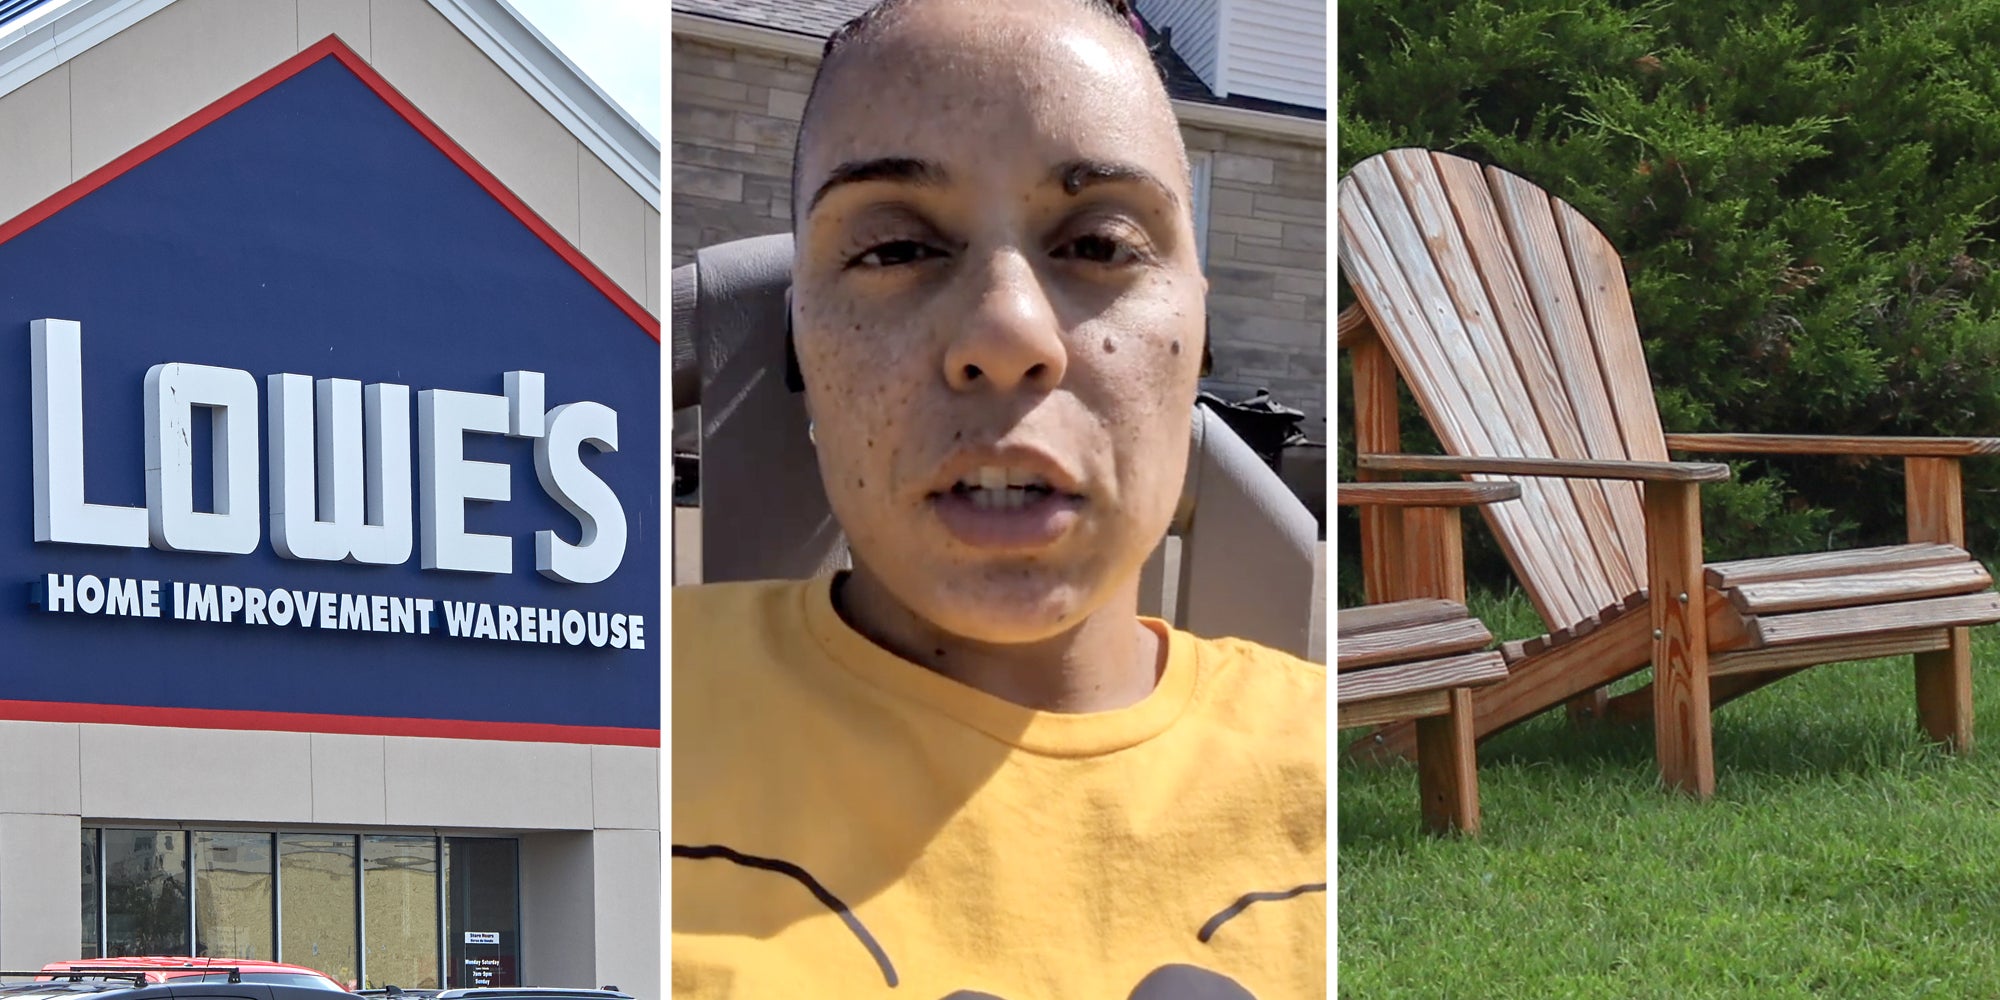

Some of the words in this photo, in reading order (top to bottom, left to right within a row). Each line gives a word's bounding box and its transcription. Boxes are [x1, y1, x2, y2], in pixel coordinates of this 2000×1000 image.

[30, 318, 627, 584] LOWE'S
[48, 573, 160, 618] HOME
[173, 582, 434, 635] IMPROVEMENT
[443, 600, 646, 650] WAREHOUSE
